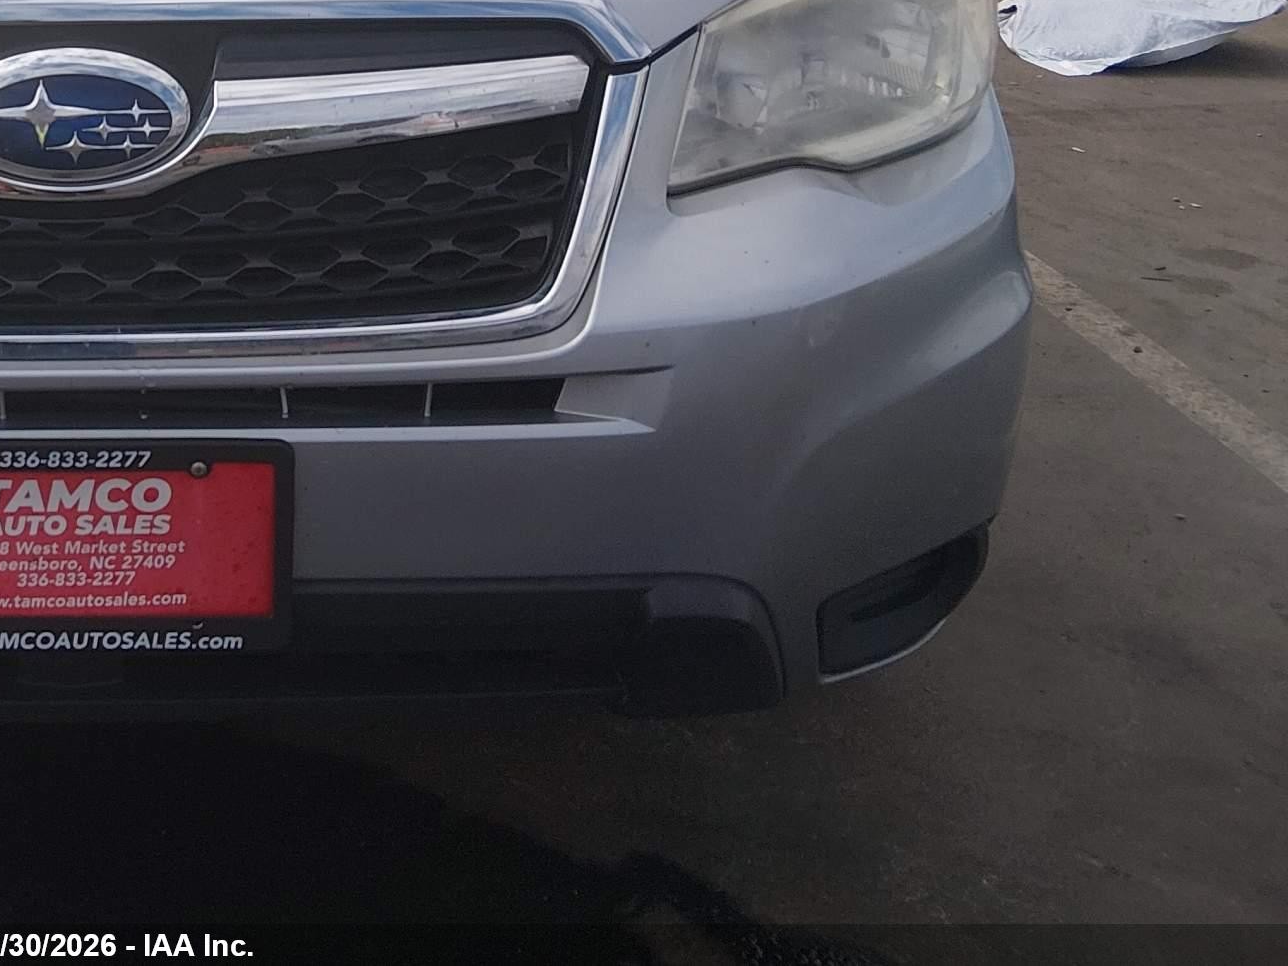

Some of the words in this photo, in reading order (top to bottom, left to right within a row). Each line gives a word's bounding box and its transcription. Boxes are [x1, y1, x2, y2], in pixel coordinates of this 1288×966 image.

[75, 514, 172, 536] SALES
[15, 541, 59, 555] West
[64, 541, 126, 555] Market
[131, 539, 186, 553] Street
[89, 555, 117, 569] NC
[121, 555, 176, 569] 27409
[16, 571, 136, 587] 336-833-2277
